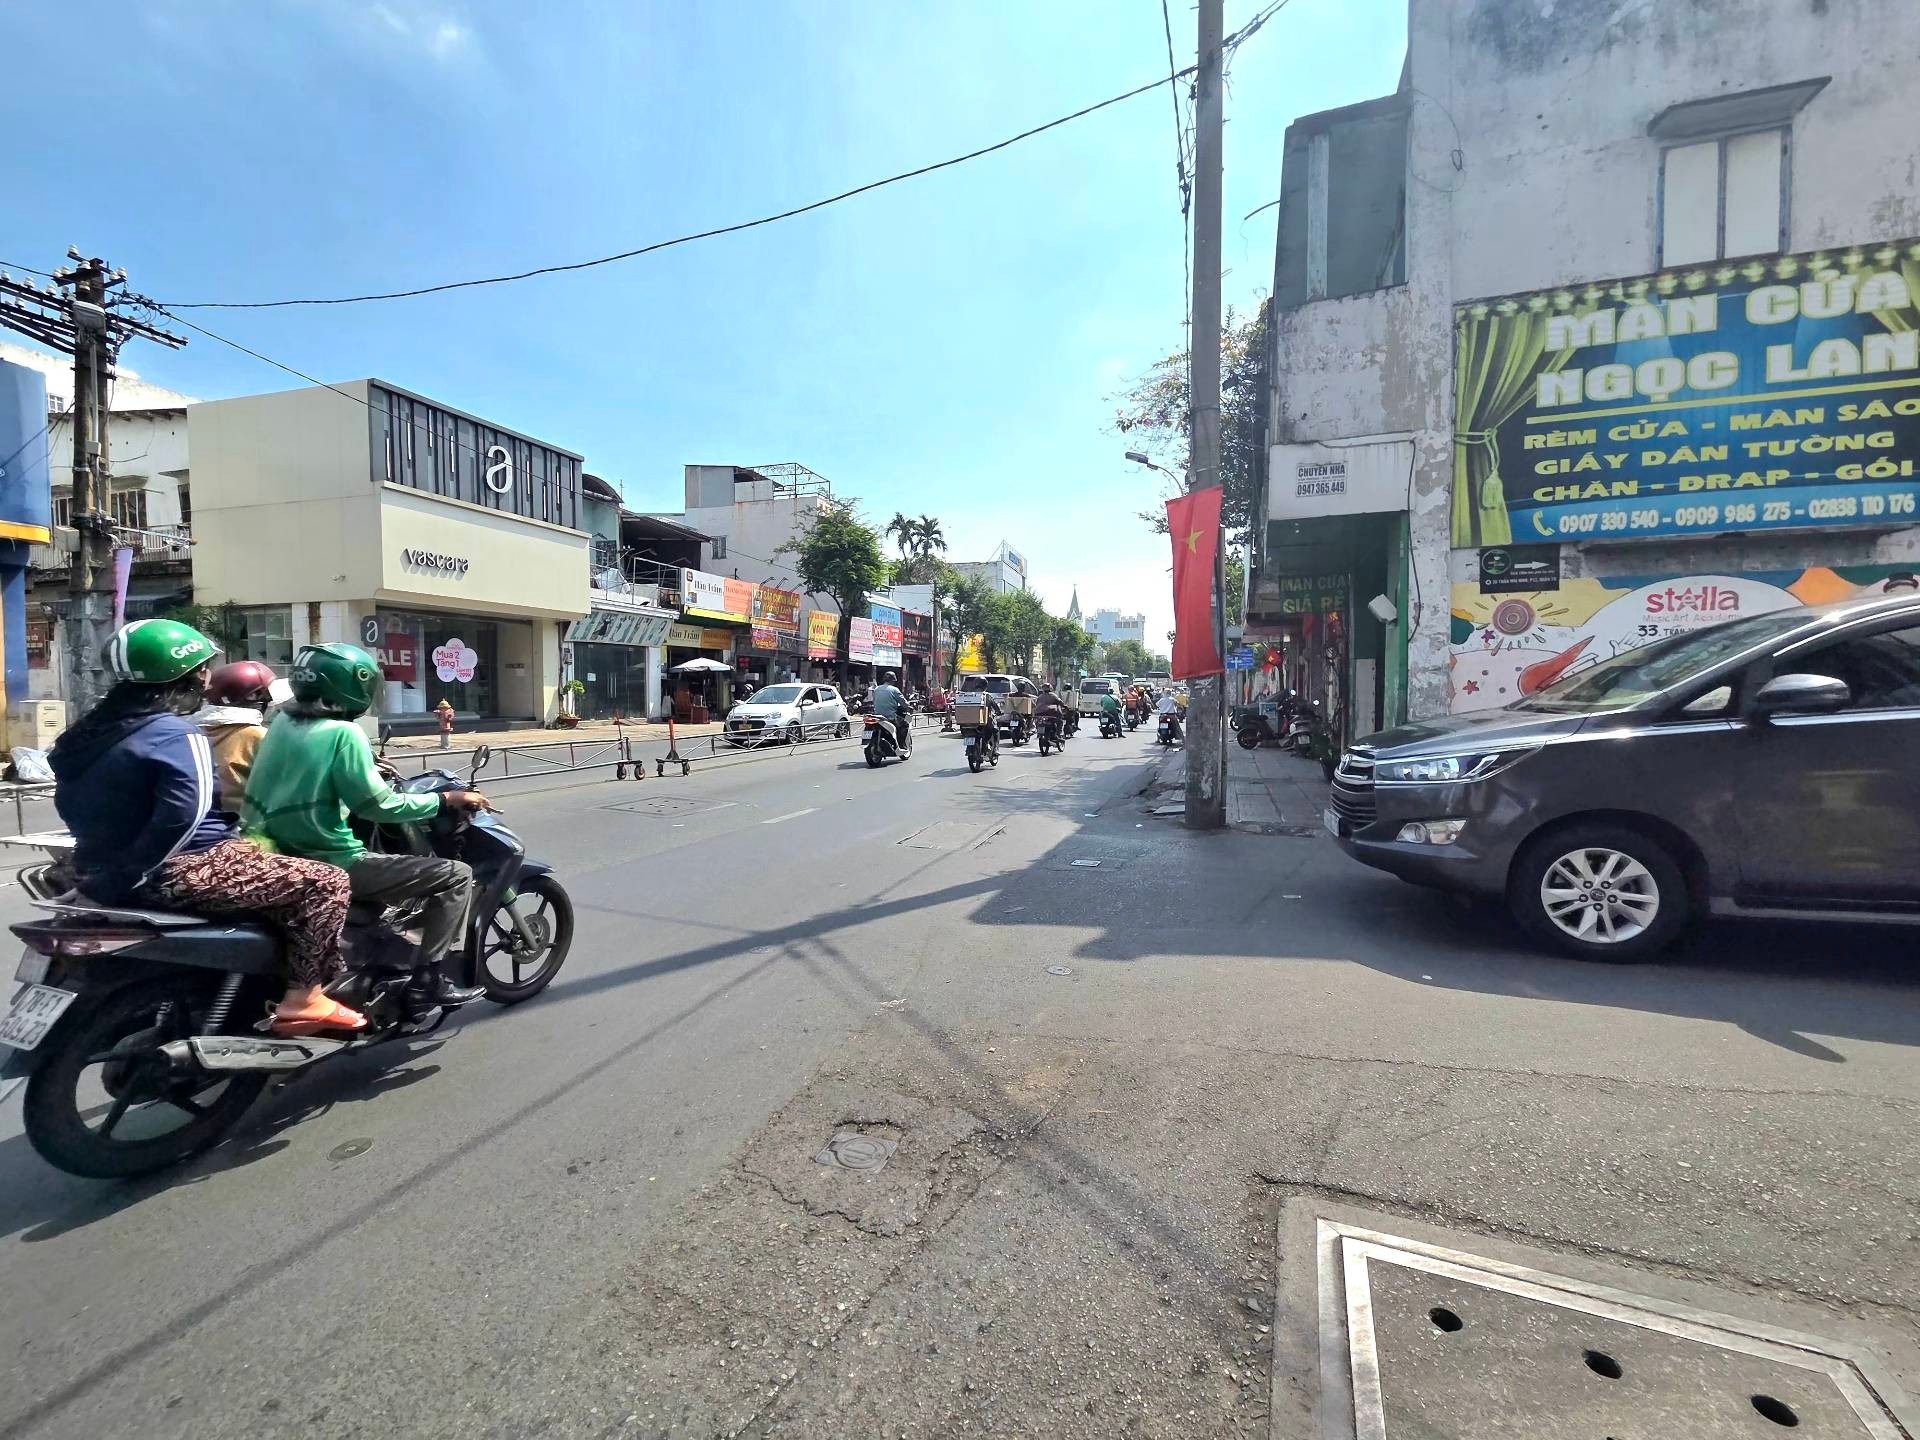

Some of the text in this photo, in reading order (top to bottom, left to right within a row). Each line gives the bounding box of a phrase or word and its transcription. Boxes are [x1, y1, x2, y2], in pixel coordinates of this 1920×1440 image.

[1544, 293, 1718, 352] MÀN
[1536, 328, 1919, 408] NGỌC LAN
[1523, 429, 1597, 450] RÈM
[1608, 419, 1689, 442] CỬA
[1679, 469, 1790, 492] DRAP
[1559, 514, 1598, 534] 0907
[1675, 506, 1719, 526] 0909
[405, 548, 469, 573] vascara
[170, 640, 204, 660] Grab
[377, 649, 412, 666] ALE
